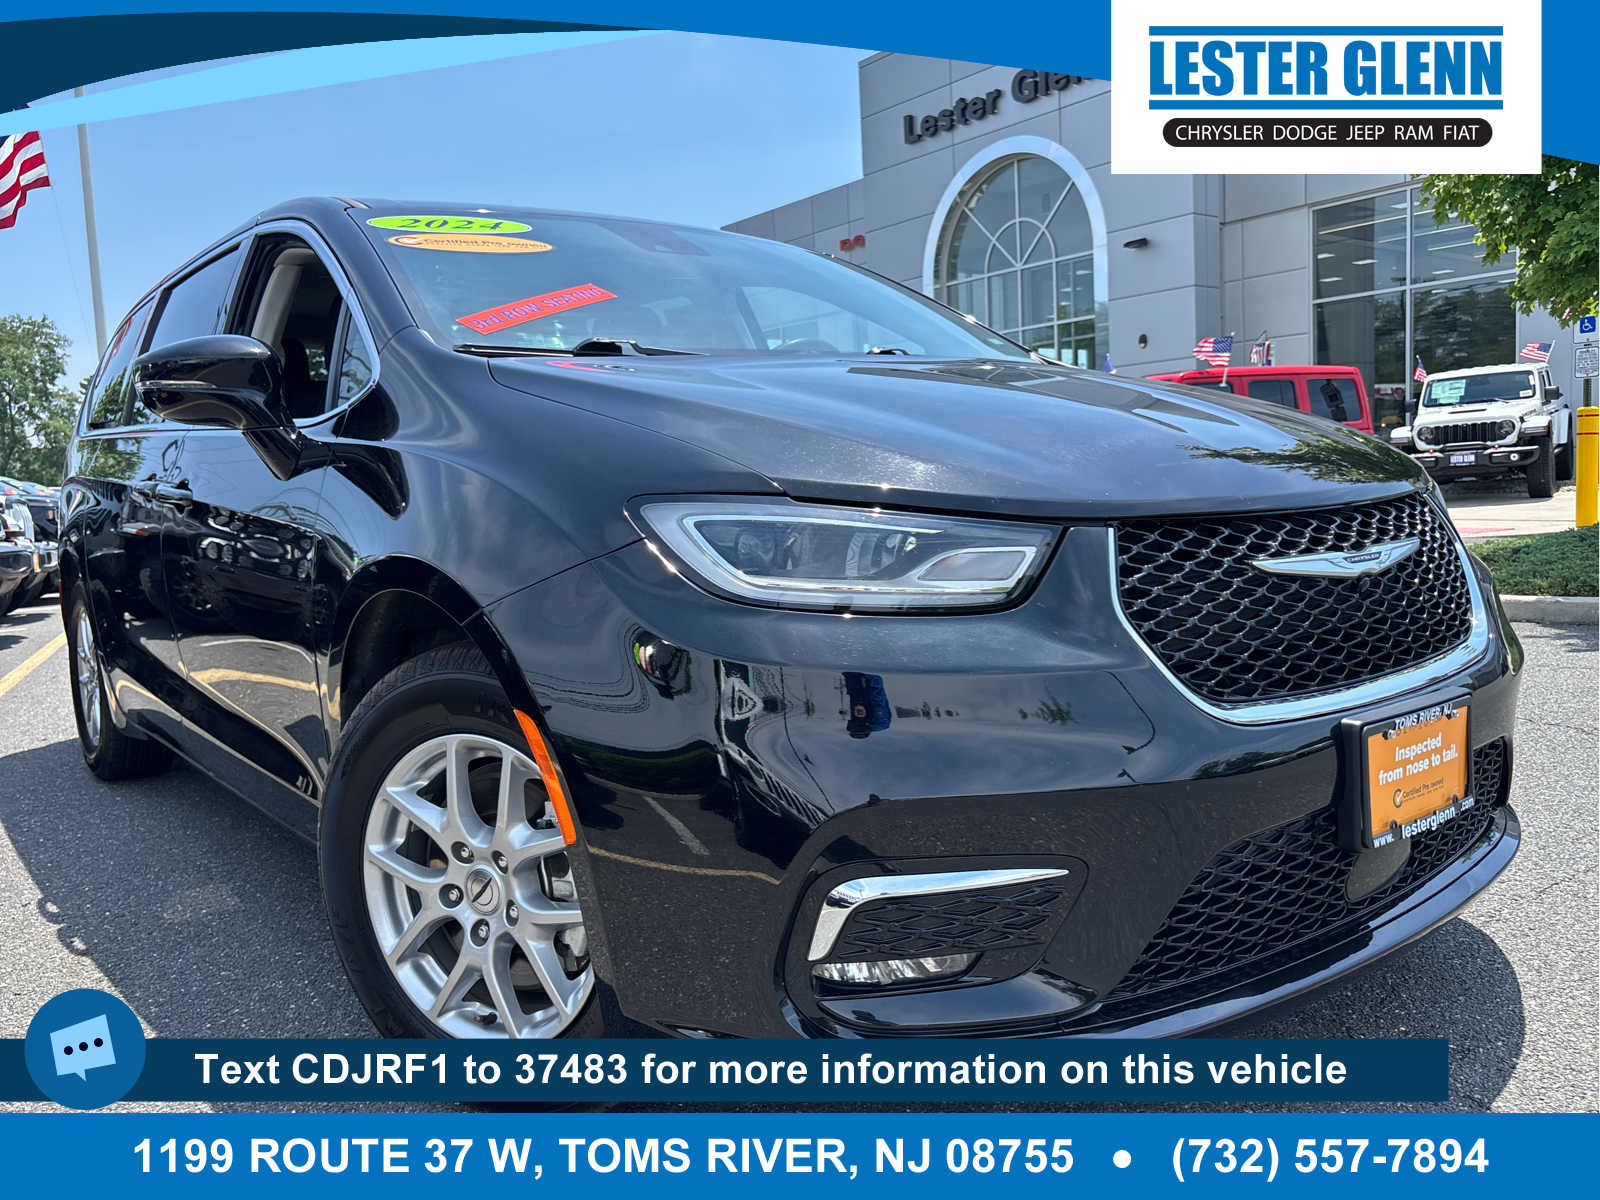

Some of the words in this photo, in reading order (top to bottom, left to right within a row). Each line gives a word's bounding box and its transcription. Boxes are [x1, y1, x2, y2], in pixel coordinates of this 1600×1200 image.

[904, 88, 1002, 144] Lester
[1011, 68, 1096, 104] Glen
[397, 218, 504, 230] 2024
[470, 312, 503, 329] 3rd
[502, 302, 542, 320] ROW
[541, 287, 604, 307] SEATING
[1394, 714, 1418, 732] TOMS
[1378, 766, 1403, 786] from
[1406, 757, 1430, 776] nose
[1431, 754, 1441, 768] to
[1442, 744, 1458, 763] tail.
[1395, 732, 1442, 762] Inspected
[1373, 832, 1395, 848] www.
[1401, 806, 1456, 840] lesterglenn
